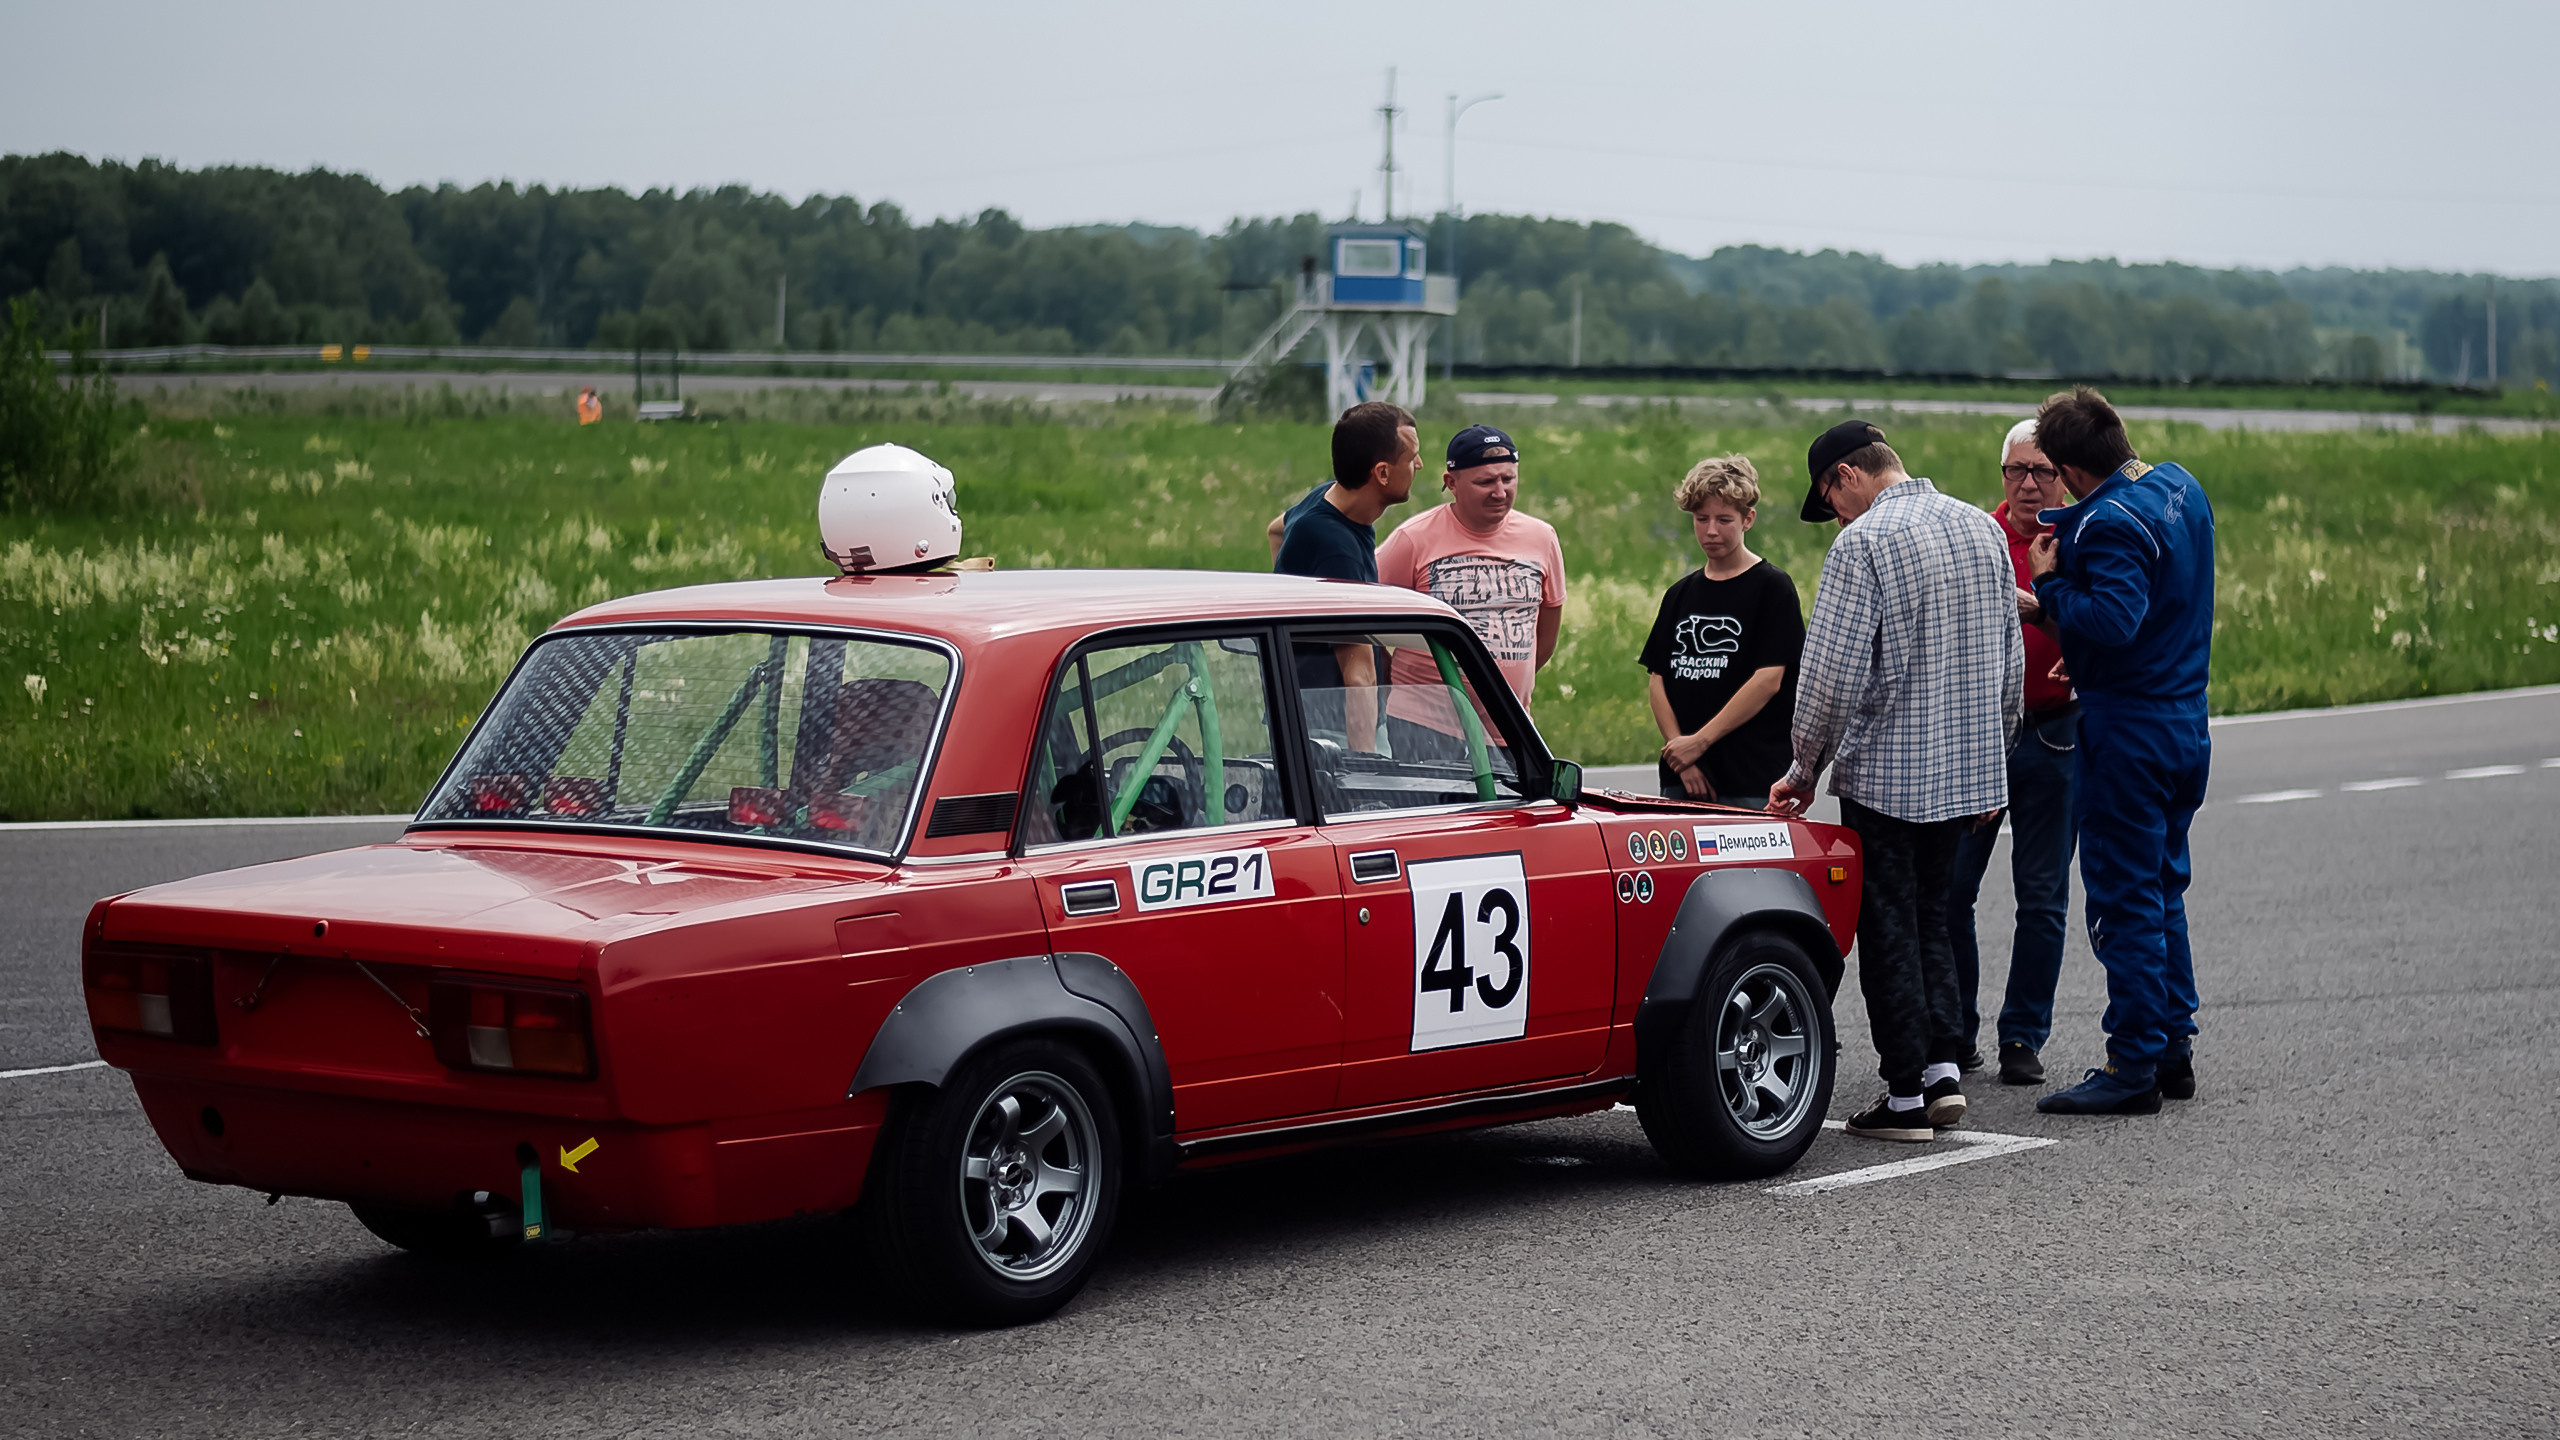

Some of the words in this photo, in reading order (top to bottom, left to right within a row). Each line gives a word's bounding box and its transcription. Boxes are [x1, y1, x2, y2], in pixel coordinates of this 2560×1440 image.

[1670, 655, 1729, 669] КБАССКИЙ
[1675, 667, 1721, 681] ТОДРОМ
[1634, 842, 1641, 853] 2
[1654, 840, 1661, 851] 3
[1675, 839, 1681, 849] 4
[1718, 834, 1768, 852] Демидов
[1768, 832, 1791, 847] В.А.
[1141, 853, 1264, 903] GR21
[1641, 881, 1648, 891] 2
[1420, 888, 1524, 1013] 43
[526, 1227, 541, 1237] OMP
